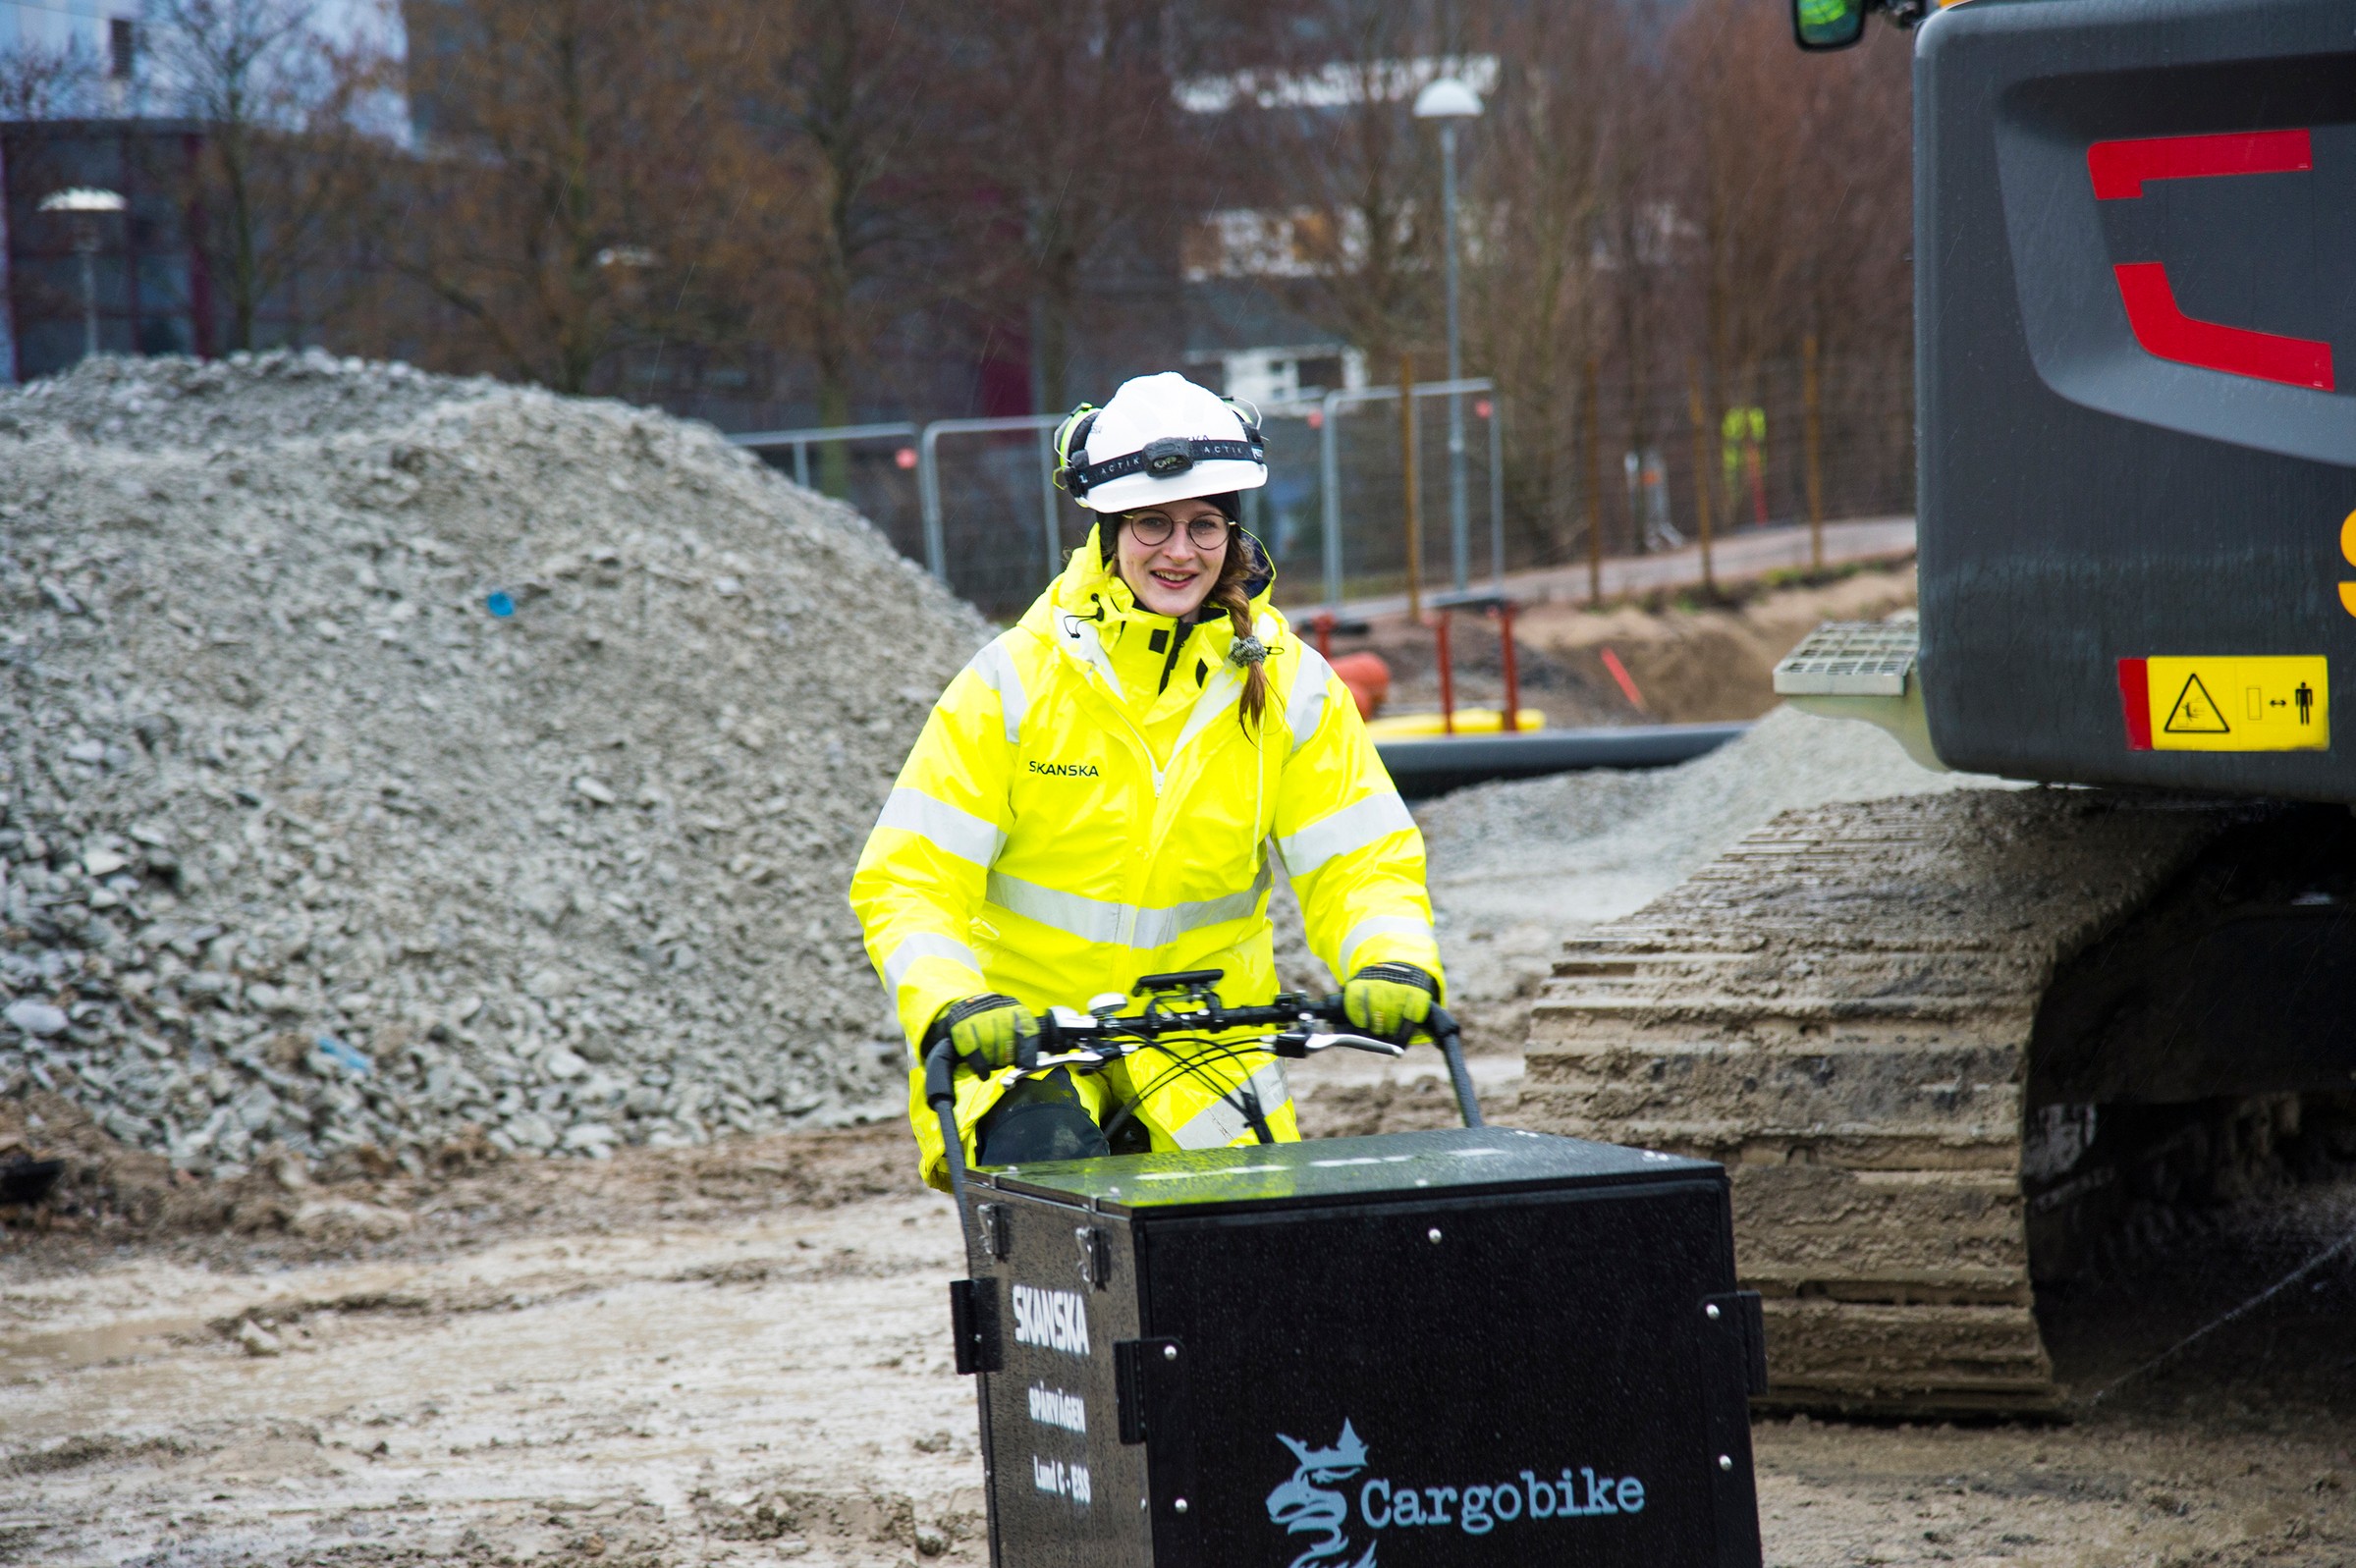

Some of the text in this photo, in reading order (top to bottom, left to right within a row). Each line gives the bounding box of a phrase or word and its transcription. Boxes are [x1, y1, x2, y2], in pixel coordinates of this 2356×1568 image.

[1101, 458, 1140, 475] ACTIK
[1028, 760, 1099, 777] SKANSKA
[1013, 1284, 1090, 1355] SKANSKA
[1028, 1379, 1085, 1433] SPÅRVÄGEN
[1033, 1454, 1058, 1491] Lund
[1057, 1461, 1066, 1494] C
[1070, 1464, 1091, 1504] ESS
[1360, 1466, 1645, 1535] Cargobike
